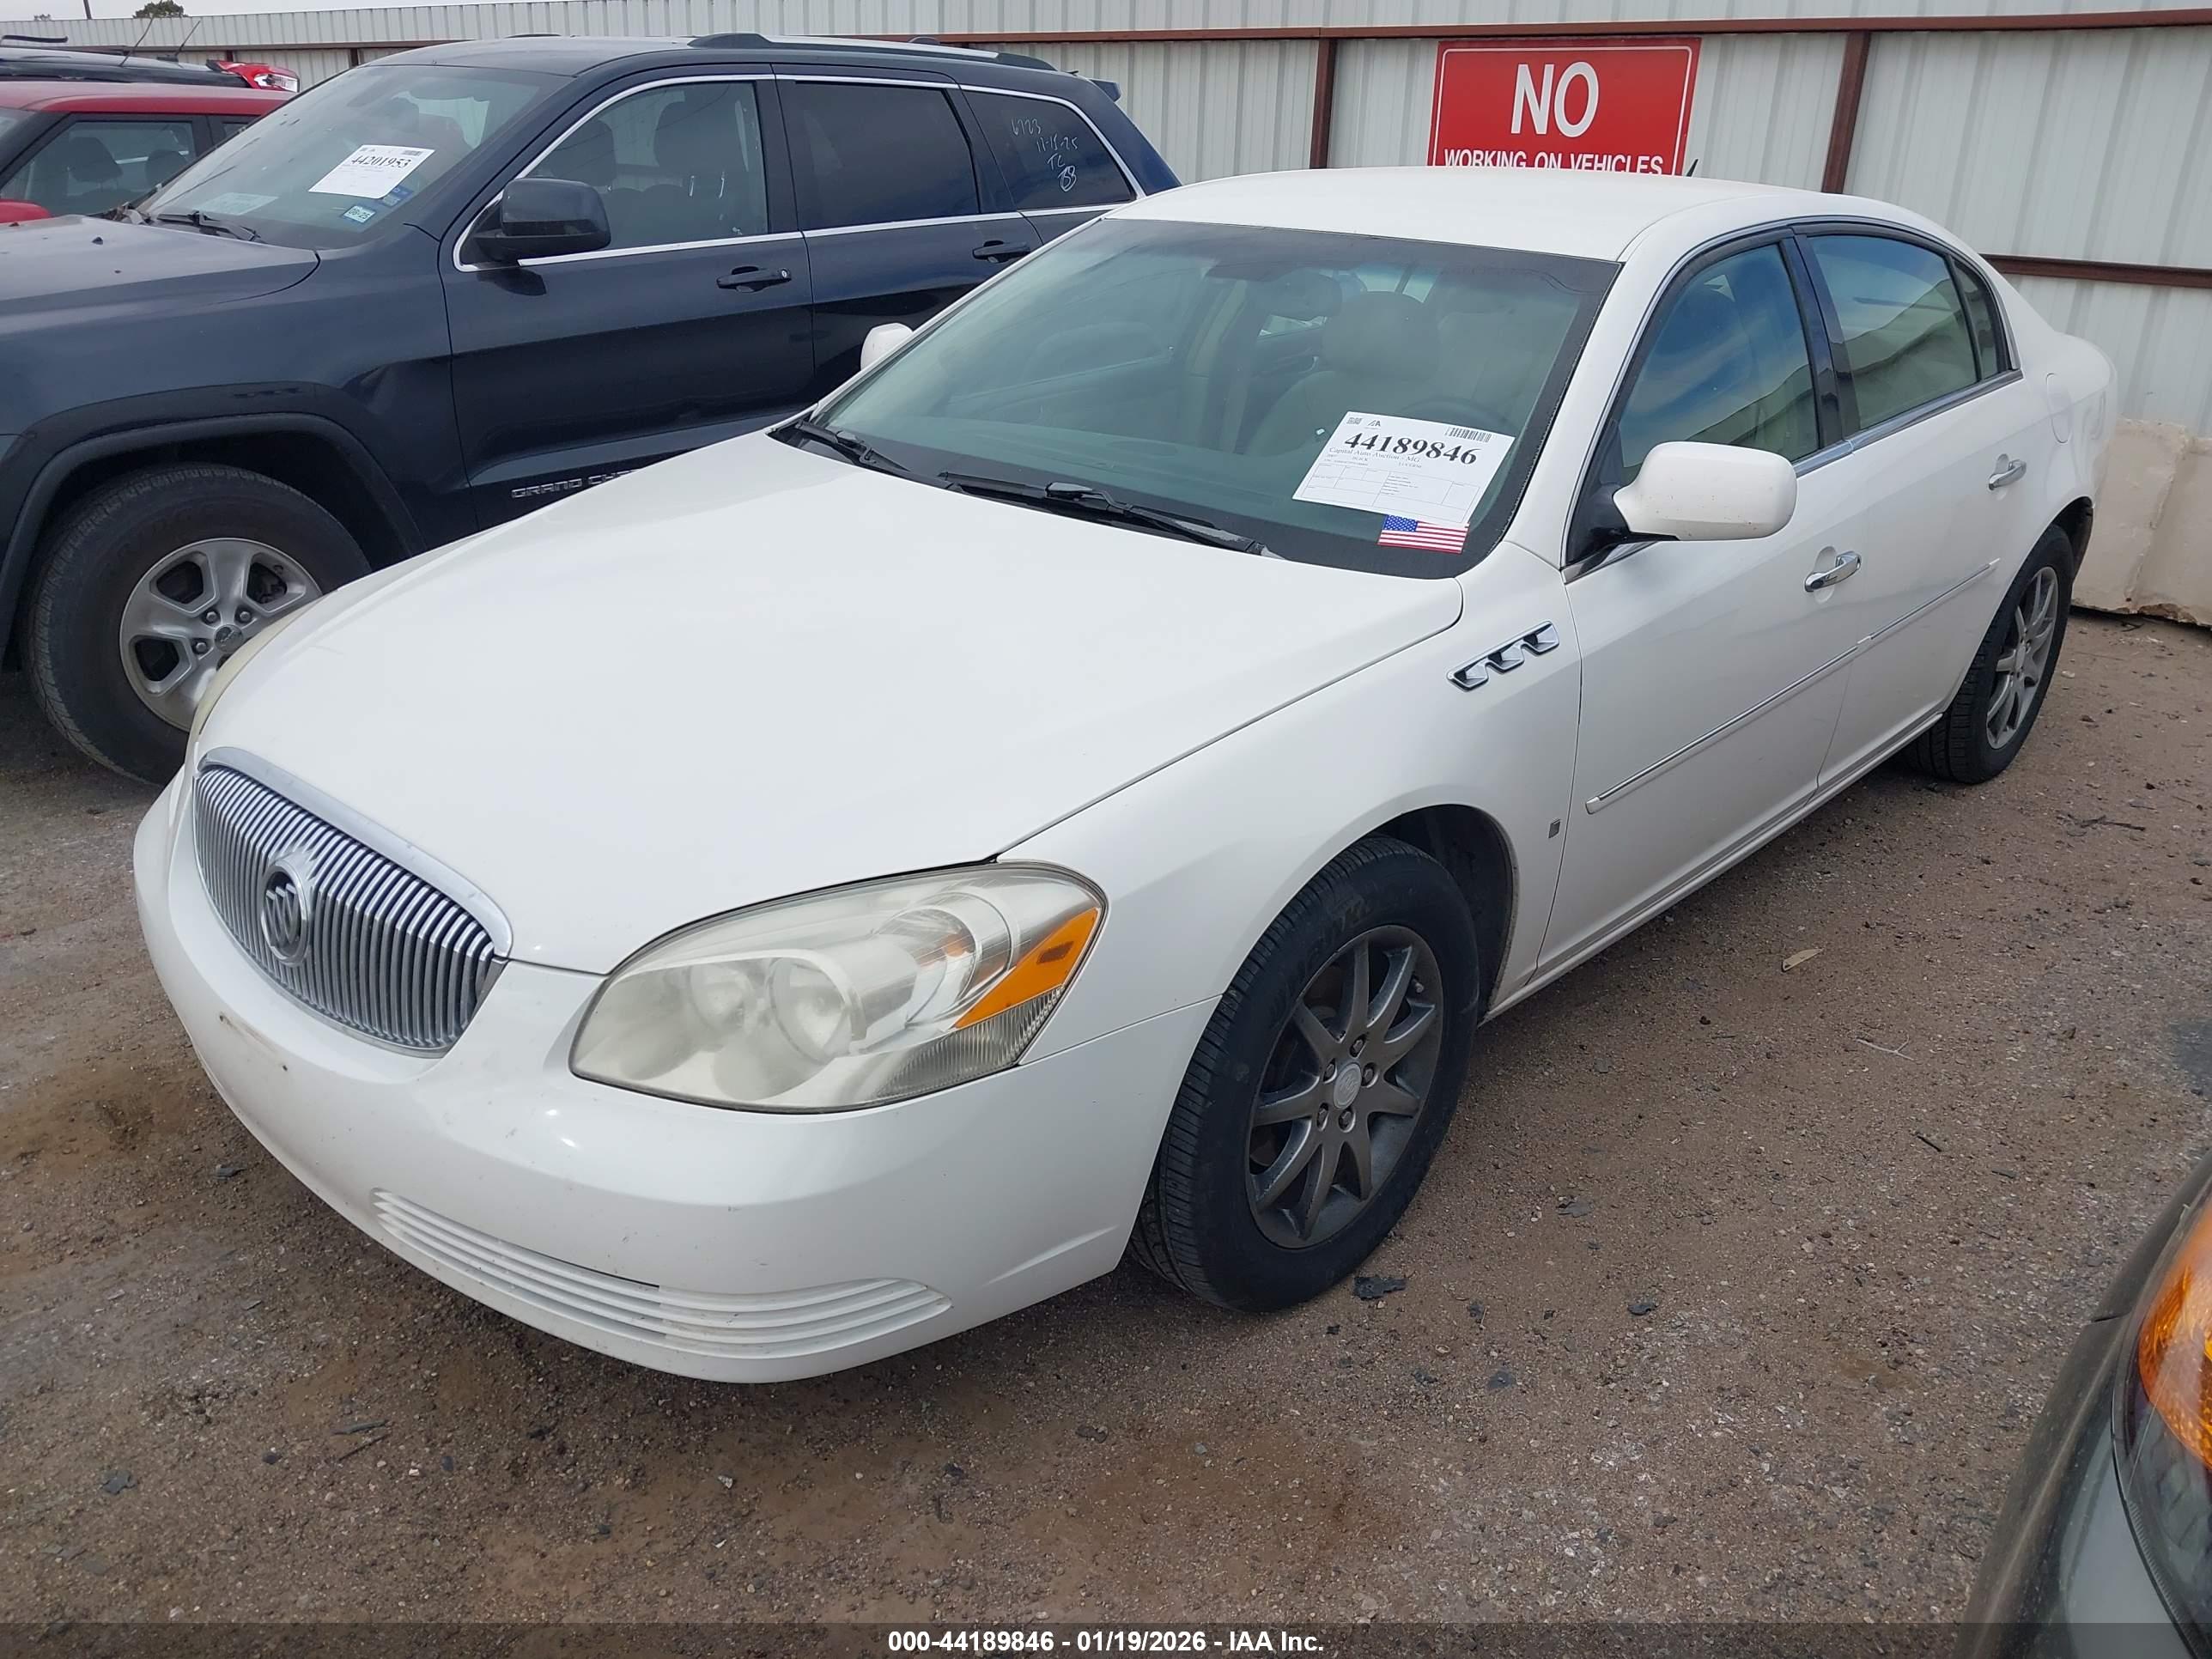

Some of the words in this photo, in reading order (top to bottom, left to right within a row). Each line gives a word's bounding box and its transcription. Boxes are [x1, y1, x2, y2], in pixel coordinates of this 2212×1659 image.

[1510, 61, 1599, 137] NO
[350, 155, 412, 168] 44201953
[1443, 149, 1527, 167] WORKING
[1534, 151, 1562, 170] ON
[1570, 153, 1663, 175] VEHICLES
[1344, 432, 1482, 465] 44189846
[512, 477, 583, 498] GRAND
